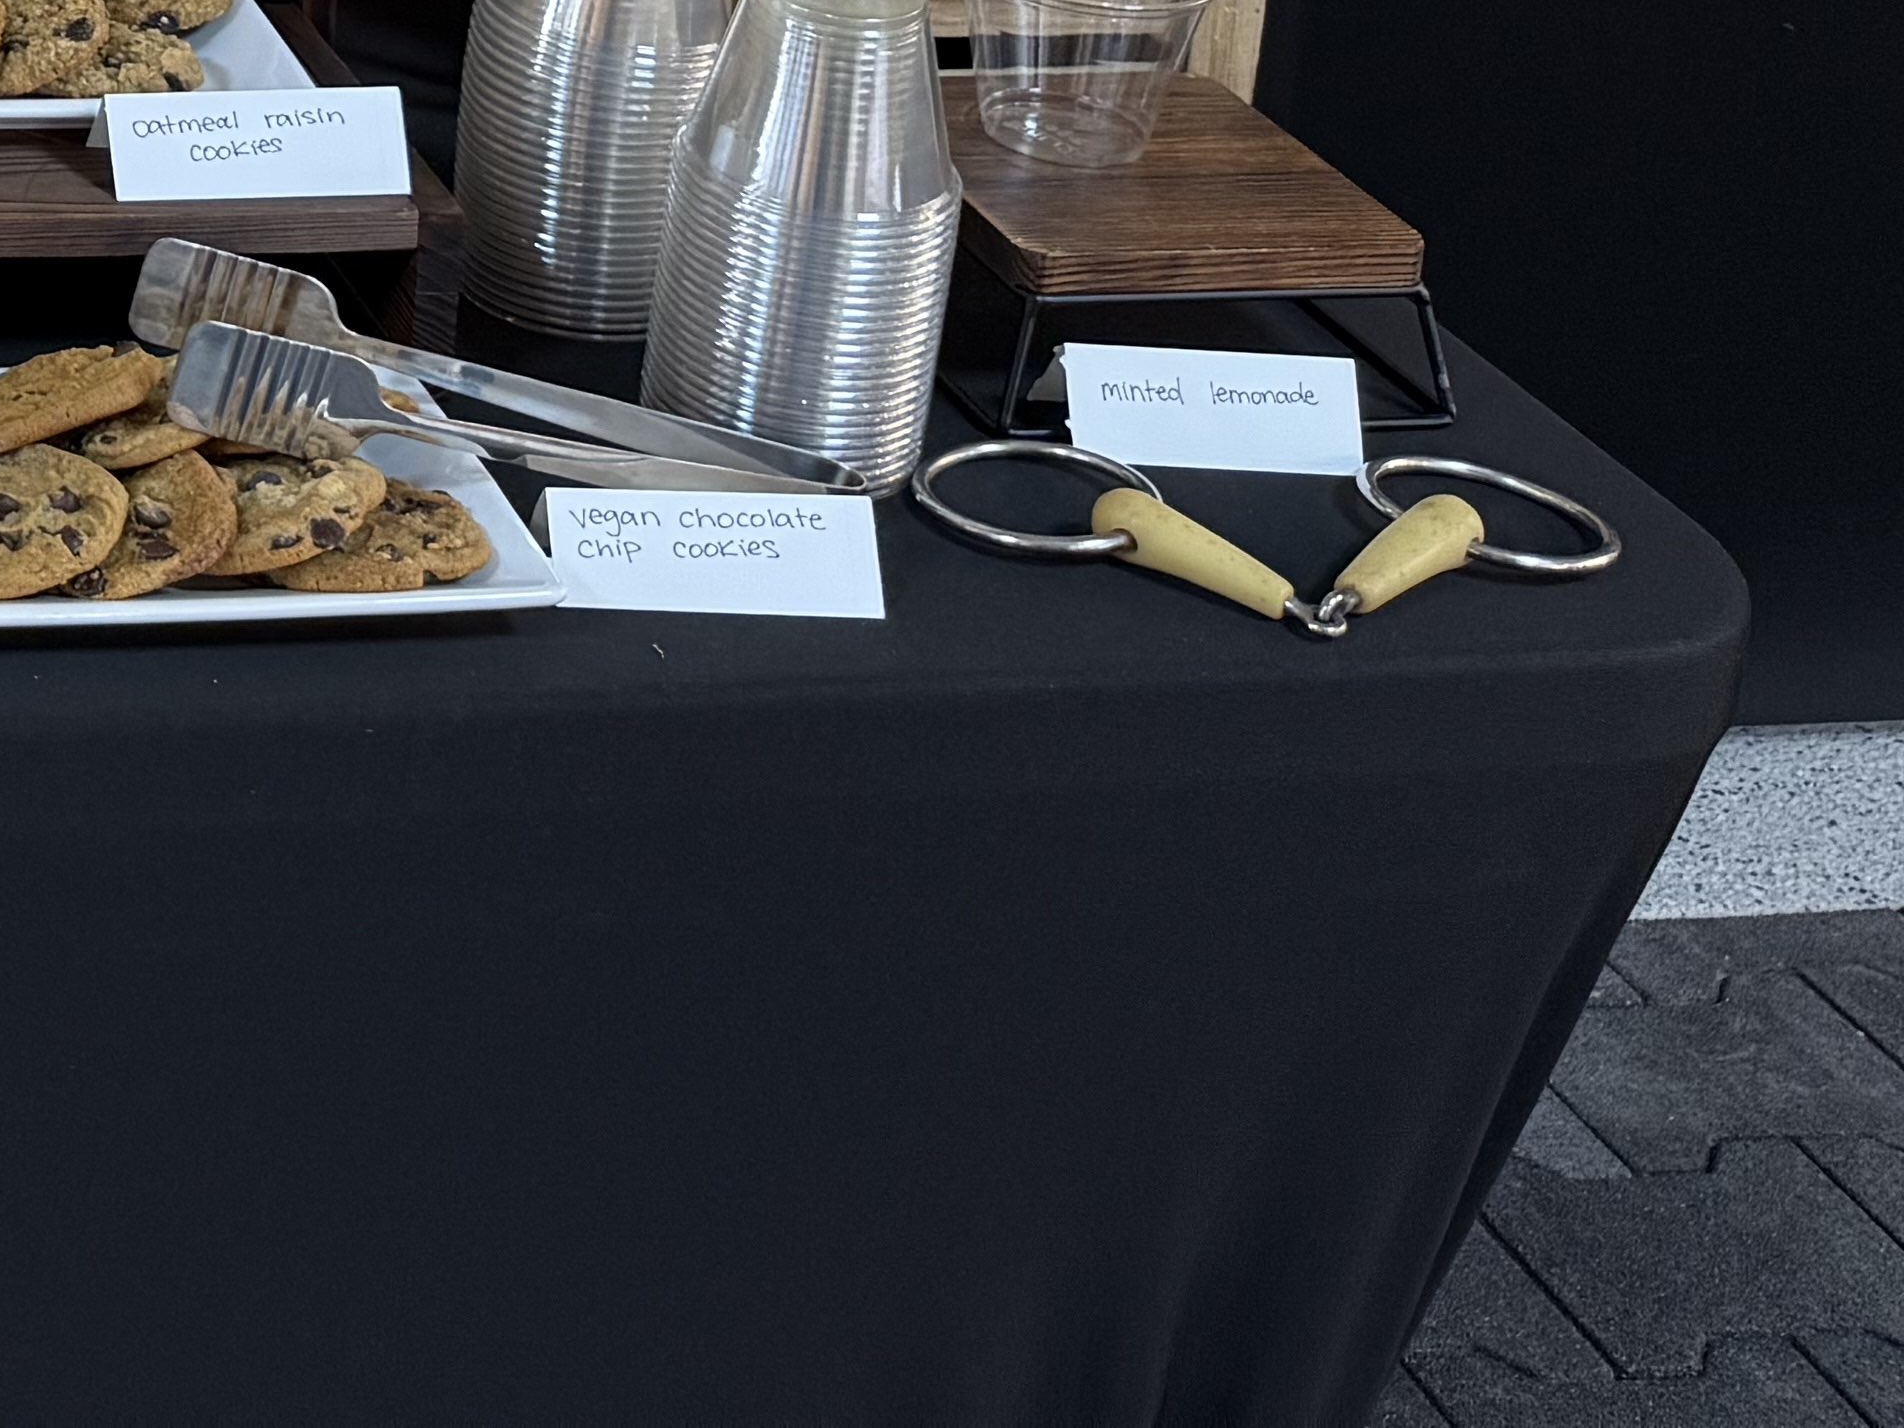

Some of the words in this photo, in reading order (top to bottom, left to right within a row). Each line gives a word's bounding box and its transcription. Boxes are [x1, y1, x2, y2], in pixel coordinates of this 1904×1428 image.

[132, 110, 239, 139] oatmeal
[263, 107, 345, 129] raisin
[189, 137, 283, 162] cookies
[1100, 376, 1185, 406] minted
[1209, 381, 1319, 406] lemonade
[568, 508, 661, 538] vegan
[678, 507, 827, 531] chocolate
[672, 539, 781, 559] cookies
